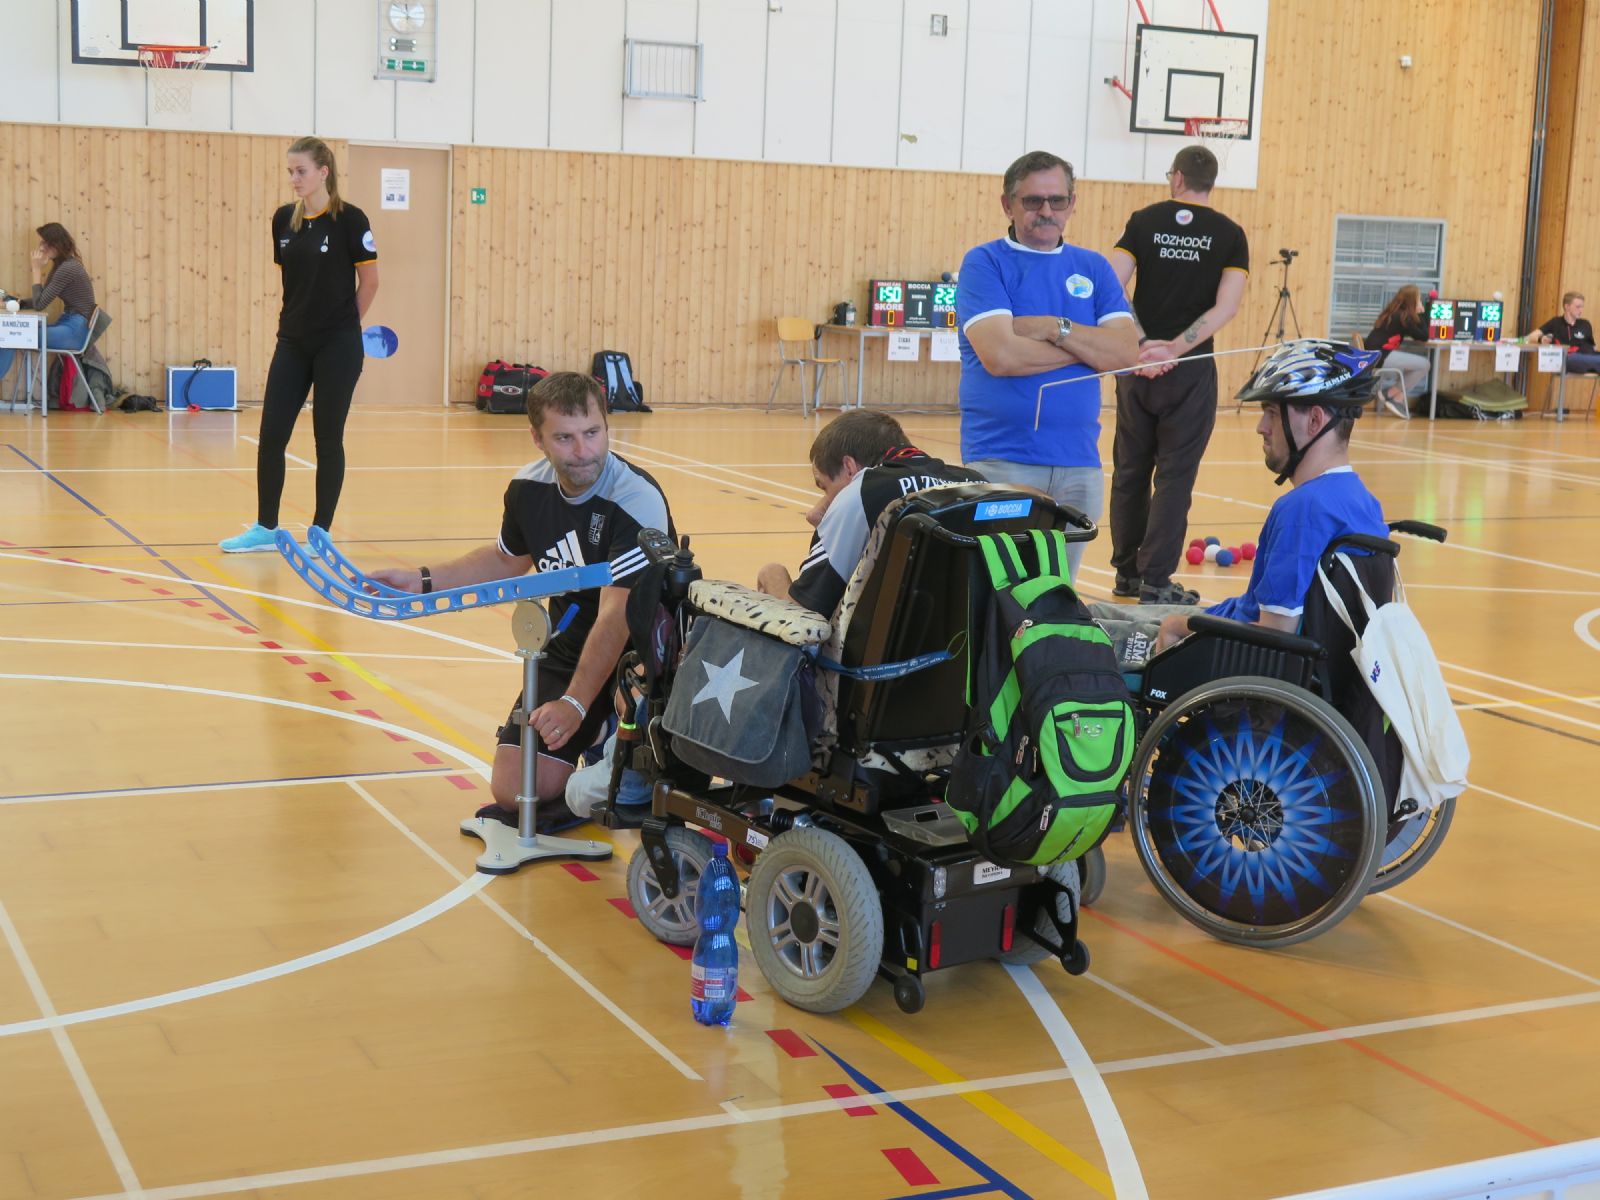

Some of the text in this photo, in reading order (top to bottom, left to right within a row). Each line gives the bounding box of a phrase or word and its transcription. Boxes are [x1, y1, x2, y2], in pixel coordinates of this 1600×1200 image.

[1153, 233, 1212, 251] ROZHODČÍ
[1159, 247, 1200, 262] BOCCIA
[887, 310, 895, 325] 0
[947, 312, 955, 326] 0
[998, 503, 1022, 514] BOCCIA
[1150, 688, 1168, 699] FOX
